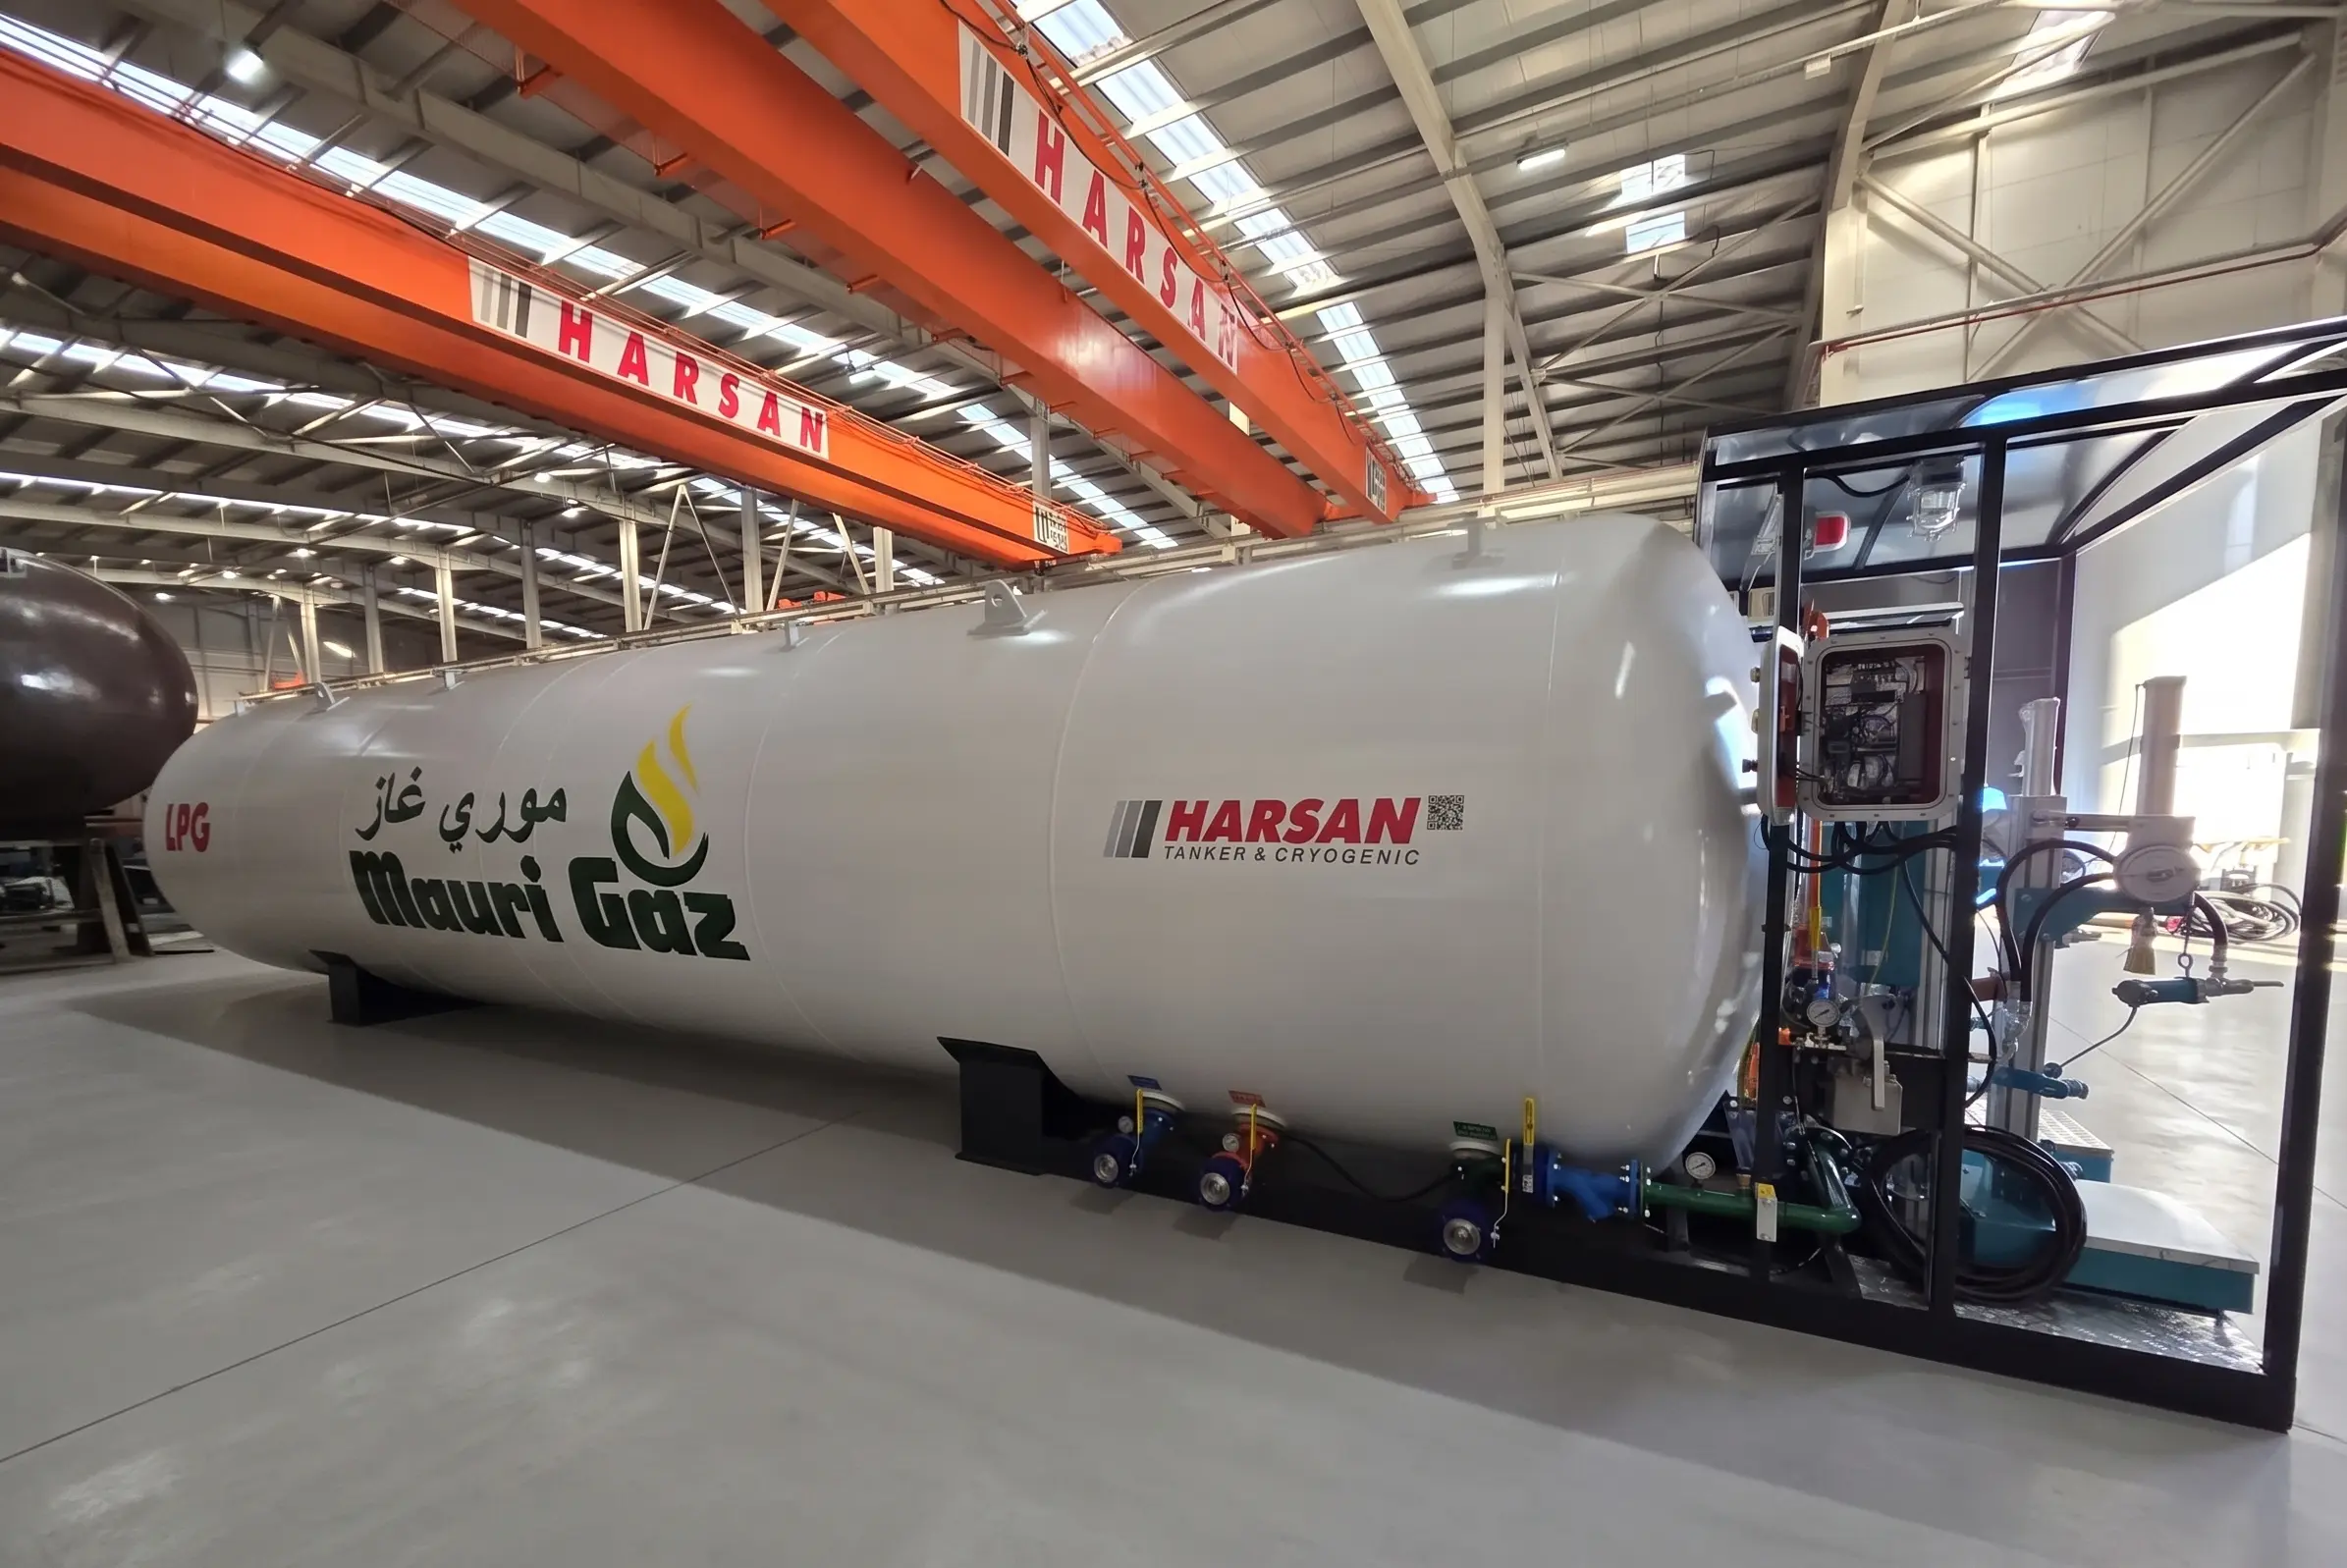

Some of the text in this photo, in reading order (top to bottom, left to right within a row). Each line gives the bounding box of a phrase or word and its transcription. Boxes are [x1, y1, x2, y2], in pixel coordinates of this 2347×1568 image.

[1034, 109, 1238, 370] HARSAN
[558, 299, 824, 454] HARSAN
[166, 802, 211, 852] LPG
[355, 766, 568, 853] موري غاز
[1165, 797, 1421, 844] HARSAN
[1164, 845, 1420, 865] TANKER & CRYOGENIC
[349, 850, 751, 961] Mauri Gaz
